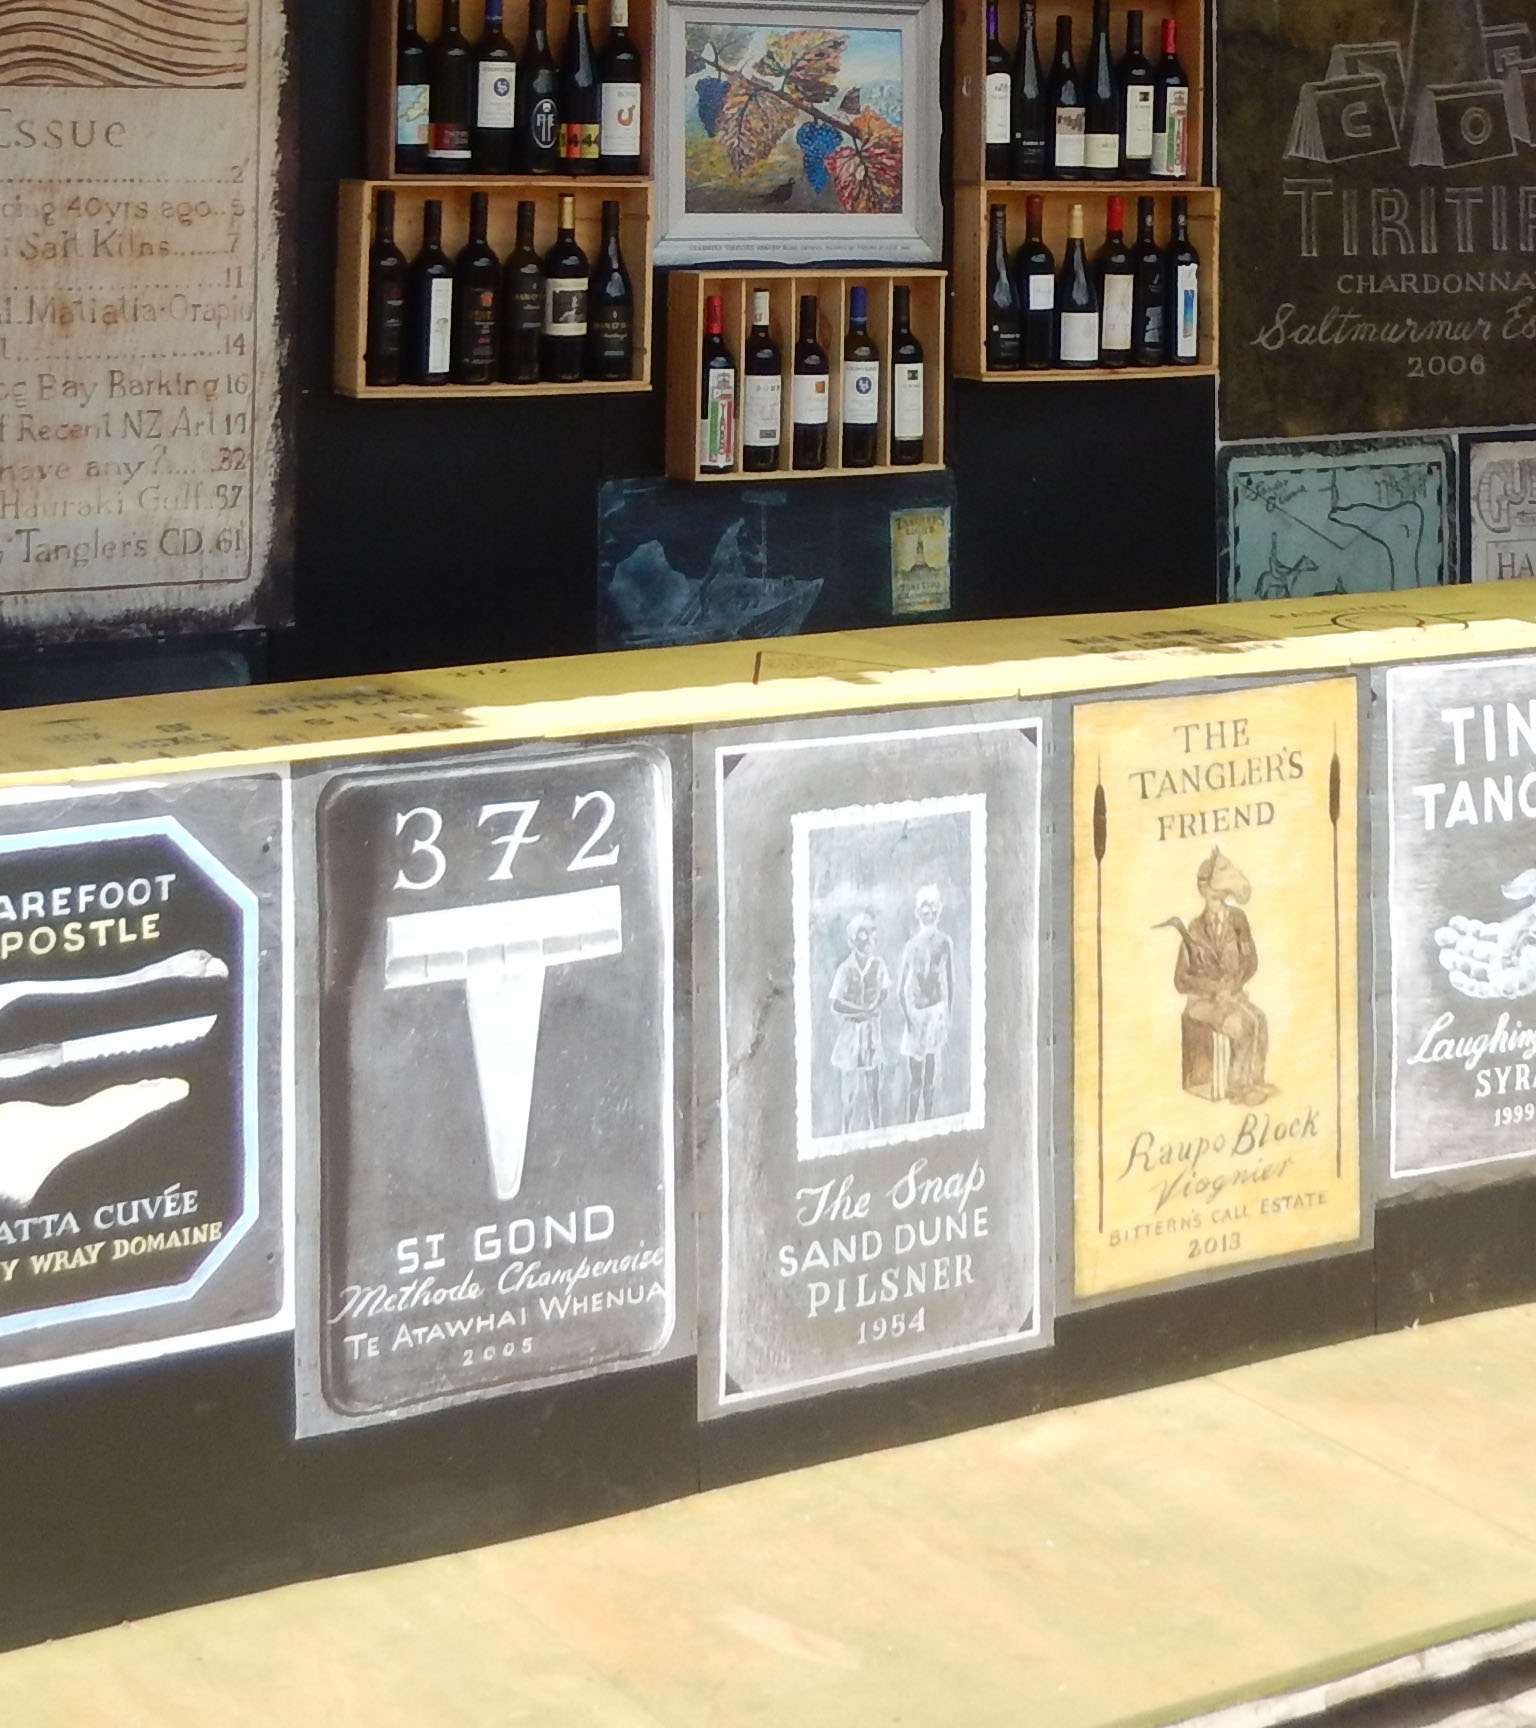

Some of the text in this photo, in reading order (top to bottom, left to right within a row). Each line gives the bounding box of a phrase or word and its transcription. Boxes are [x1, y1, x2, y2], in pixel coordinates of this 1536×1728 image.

[1407, 354, 1486, 378] 2006
[121, 408, 163, 440] NZ
[1173, 718, 1251, 754] THE
[1130, 745, 1305, 800] TANGLER'S
[393, 788, 621, 893] 372
[1157, 800, 1276, 842] FRIEND
[1117, 1106, 1321, 1182] Raupo Block
[94, 1182, 200, 1230] CUVÉE
[795, 1157, 987, 1228] The Snap
[1149, 1155, 1295, 1216] Viognier
[1211, 1203, 1249, 1225] CALL
[1260, 1190, 1329, 1215] ESTATE
[30, 1240, 108, 1275] WRAY
[112, 1221, 224, 1261] DOMAINE
[474, 1204, 616, 1263] GOND
[778, 1206, 990, 1277] SAND DUNE
[1188, 1231, 1242, 1260] 2013
[326, 1239, 666, 1325] Methode Champenoise
[806, 1254, 976, 1318] PILSNER
[392, 1307, 527, 1352] ATAWHAI
[538, 1280, 667, 1321] WHENUA
[857, 1306, 926, 1345] 1954
[462, 1337, 535, 1367] 2005
